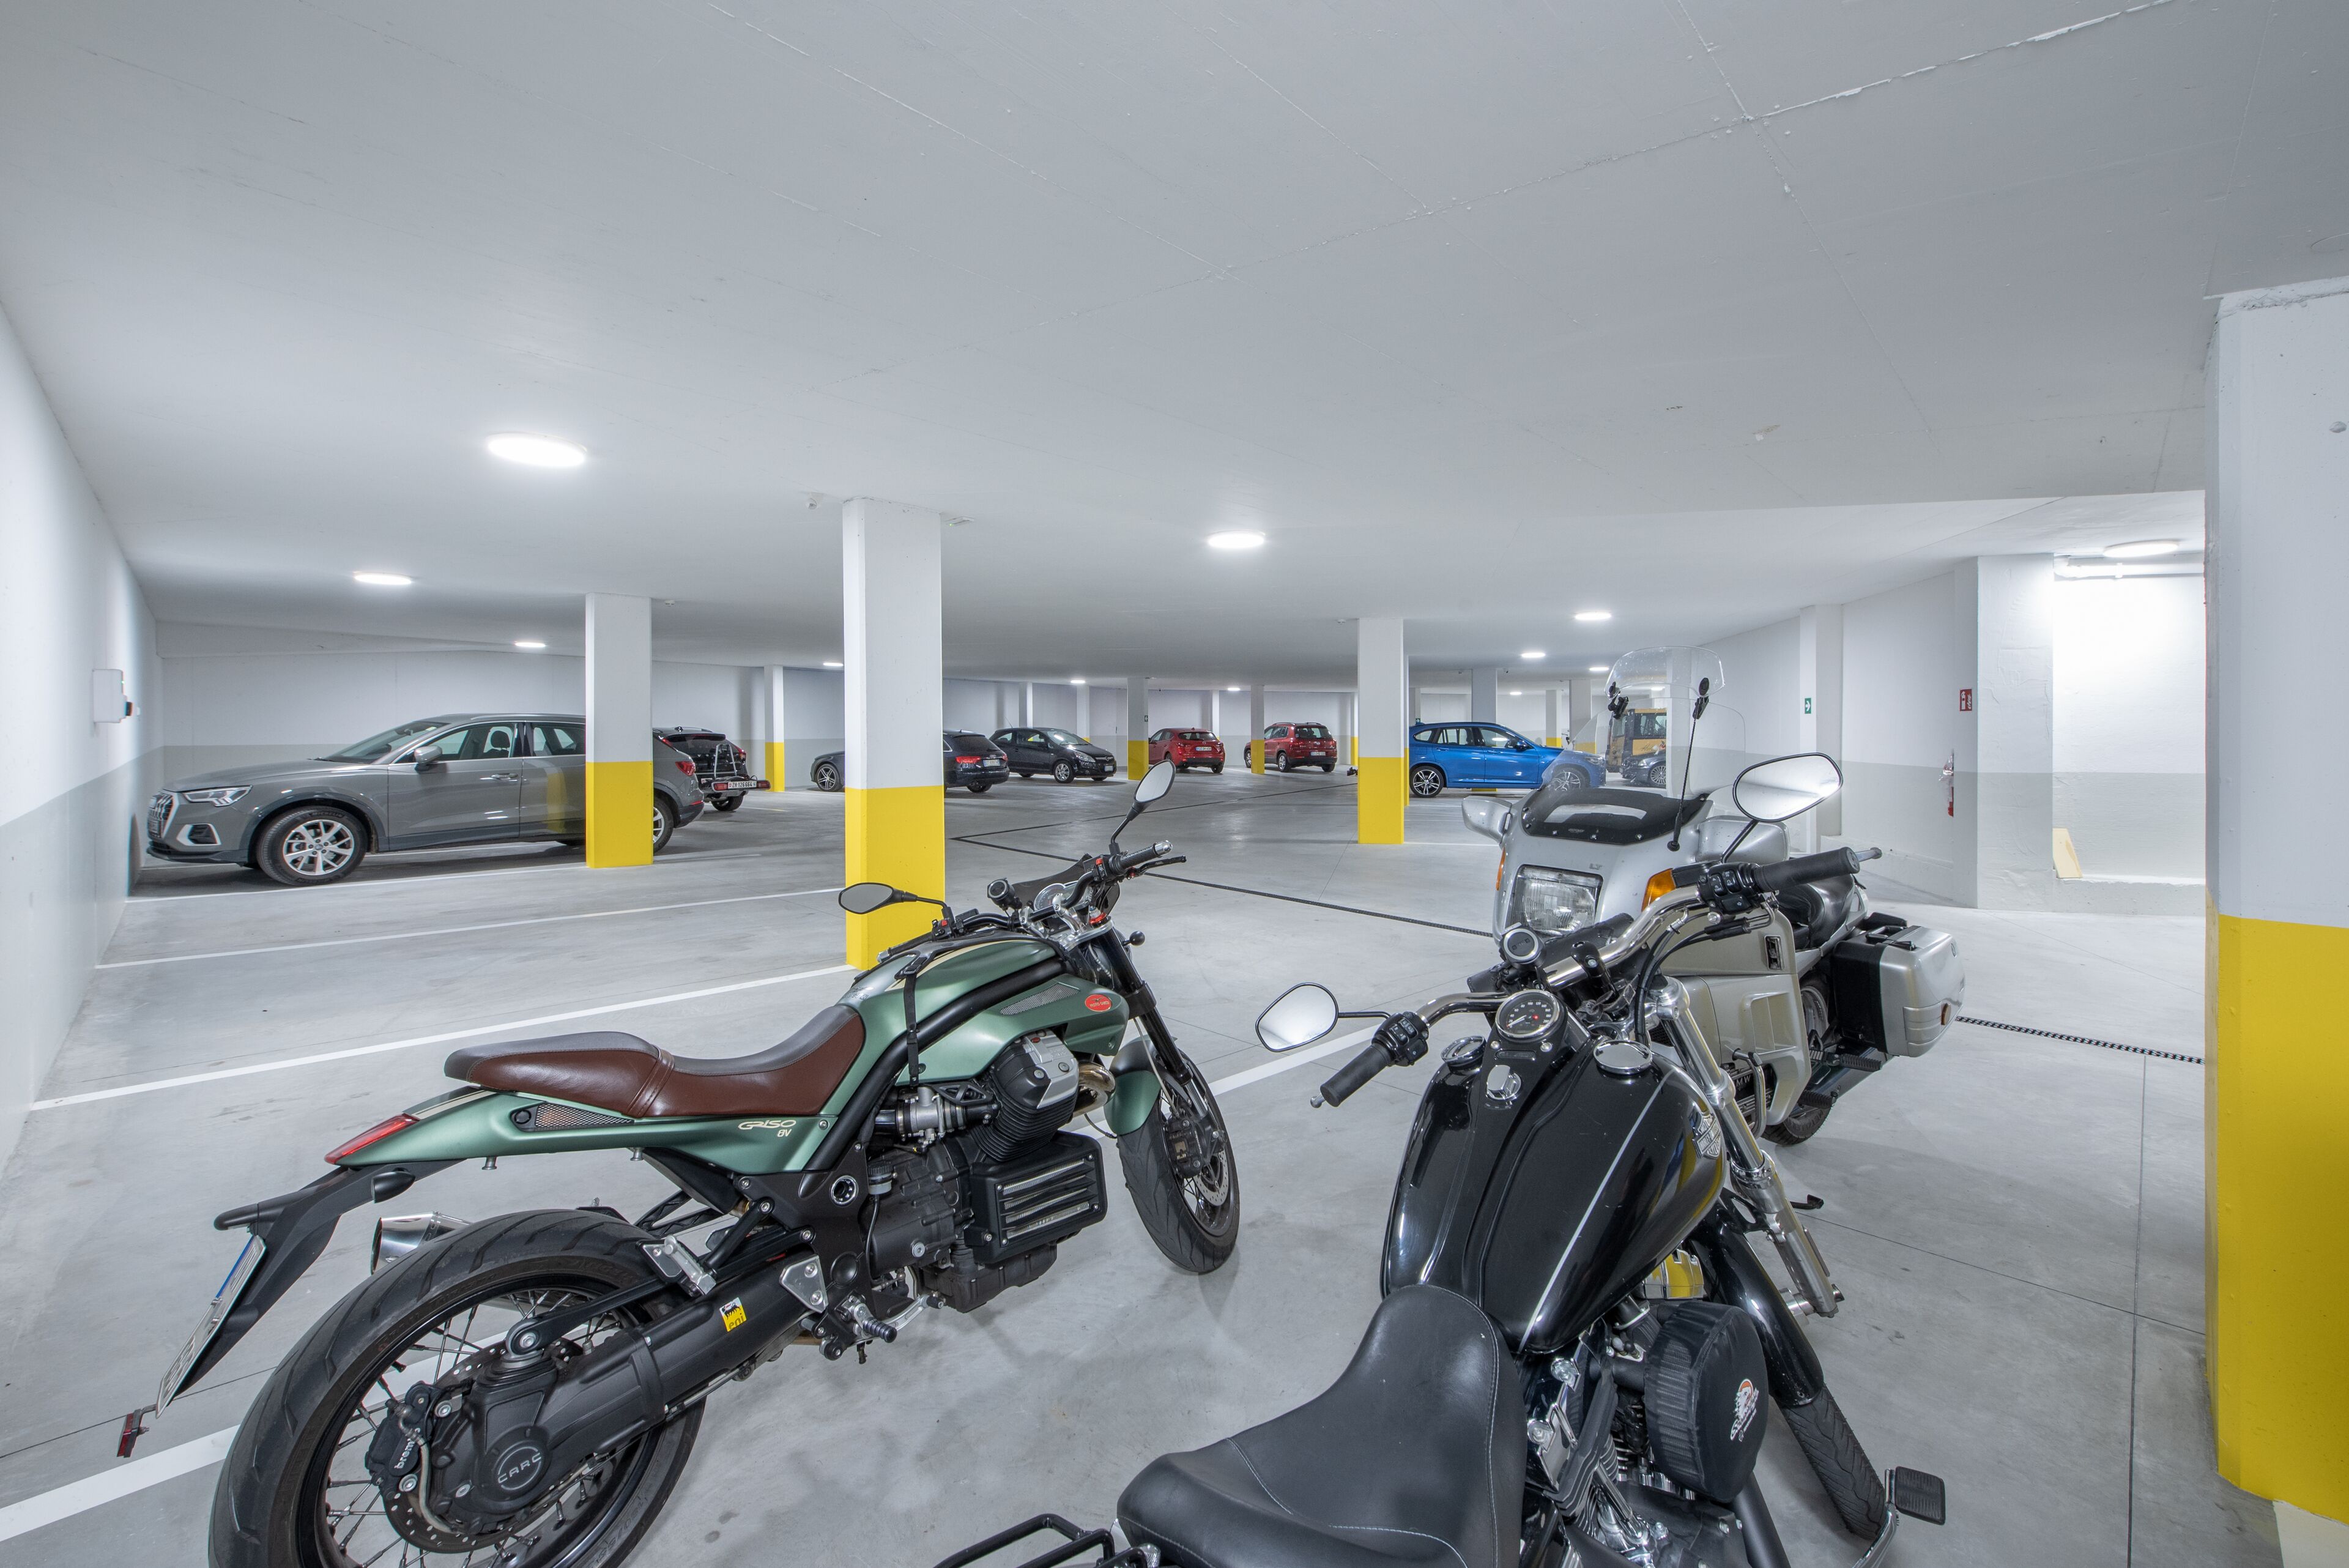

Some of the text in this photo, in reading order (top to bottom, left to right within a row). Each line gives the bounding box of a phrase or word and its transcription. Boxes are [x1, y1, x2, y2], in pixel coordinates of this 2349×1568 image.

[1737, 1075, 1751, 1087] MW
[738, 1120, 796, 1130] GRISO
[729, 1313, 744, 1329] eni
[394, 1428, 421, 1469] brem
[498, 1452, 541, 1484] CARC
